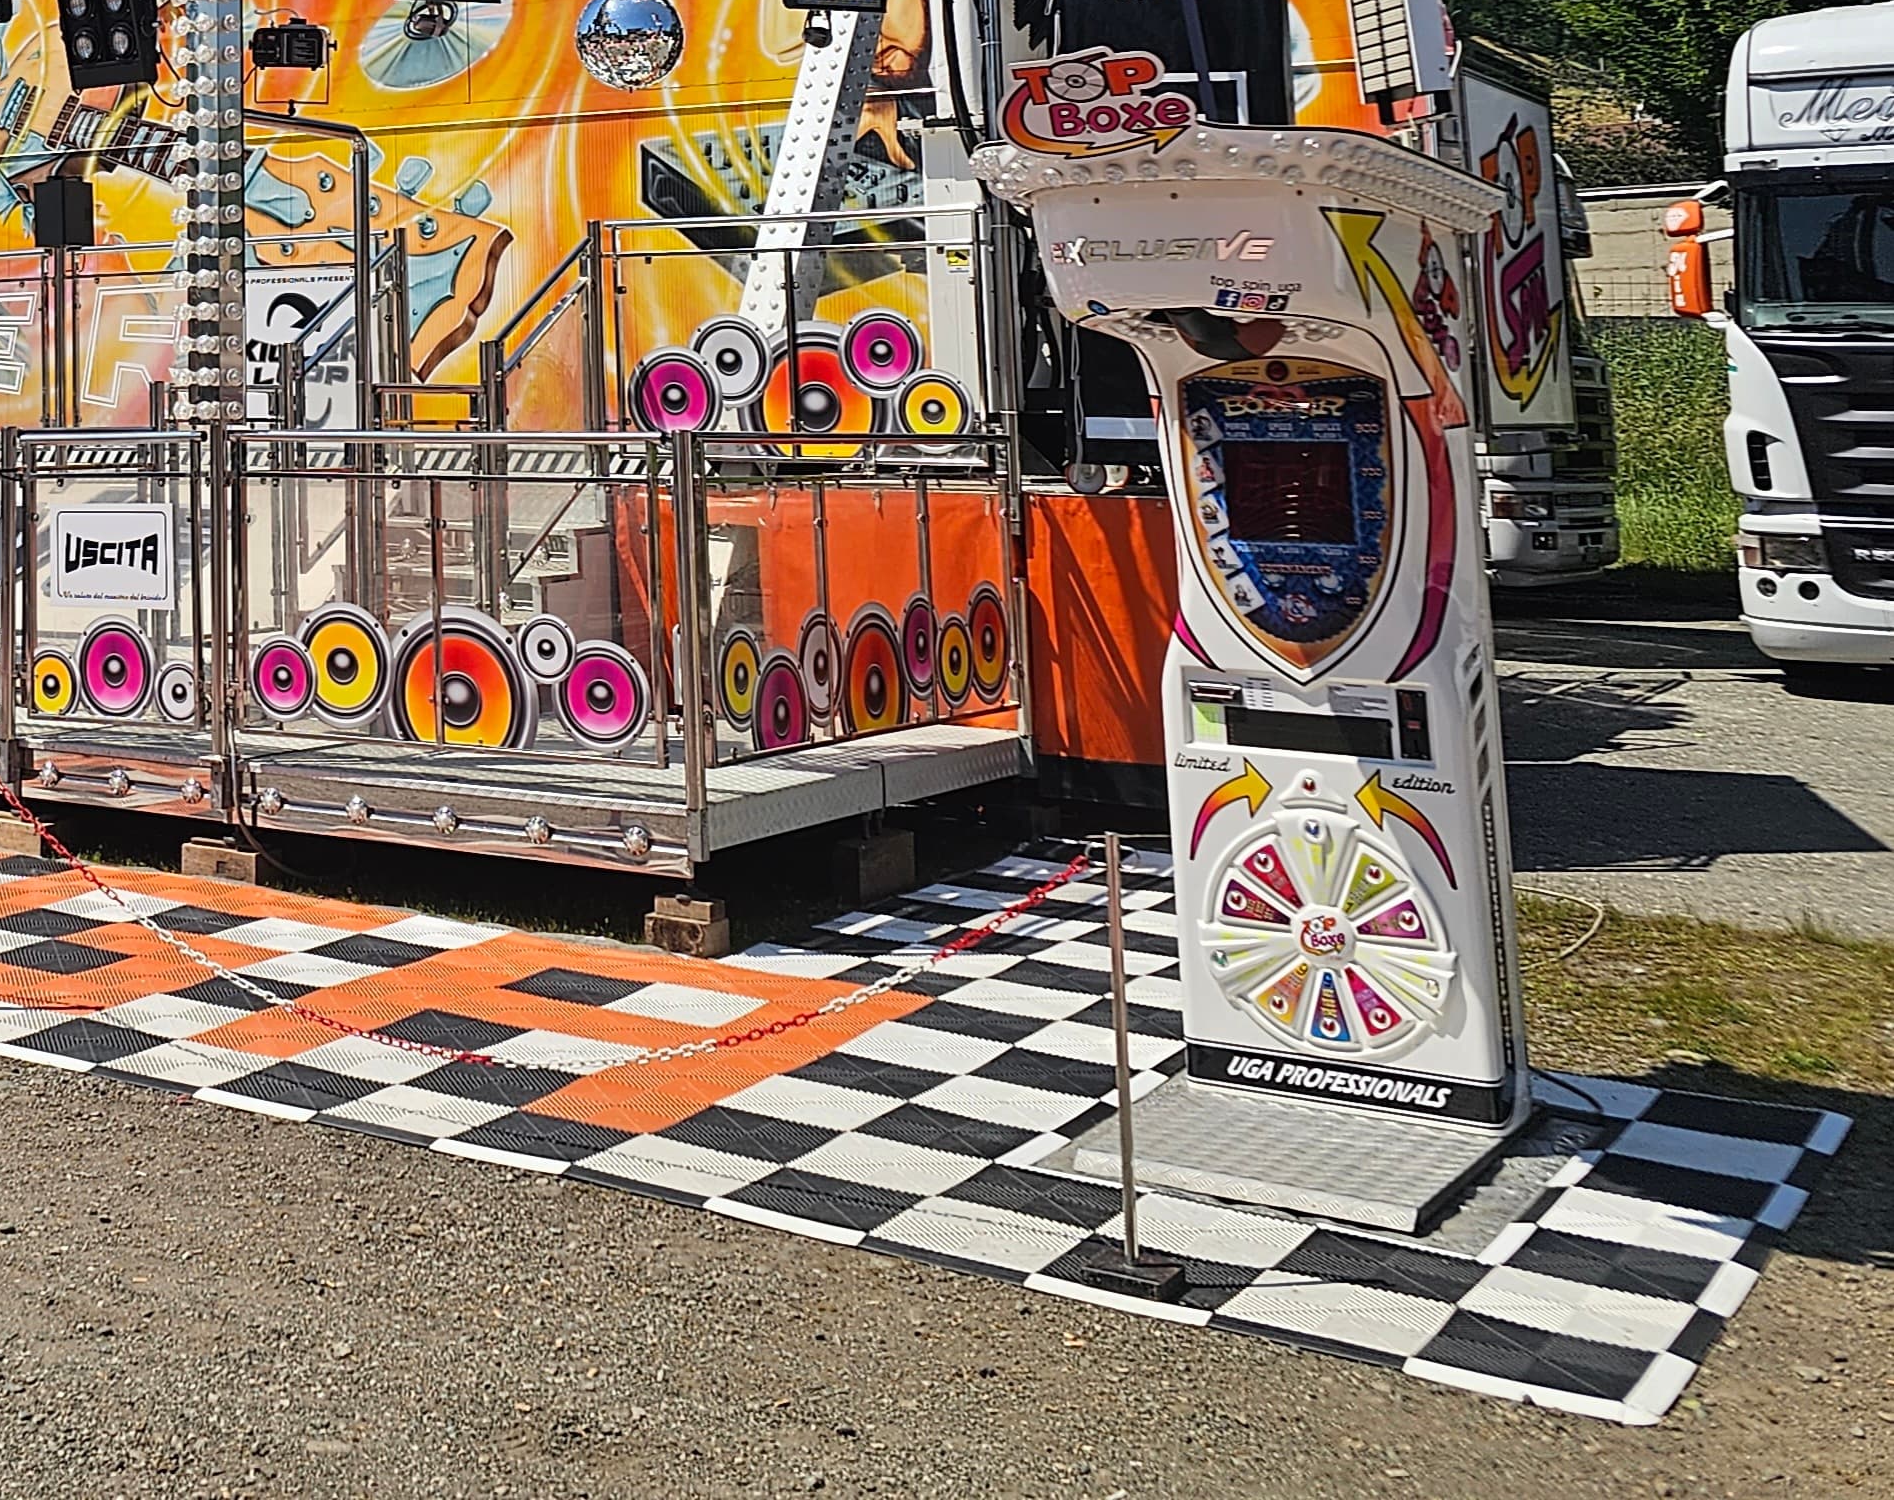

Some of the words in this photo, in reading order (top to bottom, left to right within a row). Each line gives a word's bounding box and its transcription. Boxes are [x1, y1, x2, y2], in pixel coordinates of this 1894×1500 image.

[1011, 54, 1157, 106] TOP
[65, 531, 159, 576] USCITA
[1174, 752, 1231, 773] limited
[1392, 775, 1456, 795] edition
[1226, 1055, 1276, 1082] UGA
[1274, 1063, 1453, 1109] PROFESSIONALS
